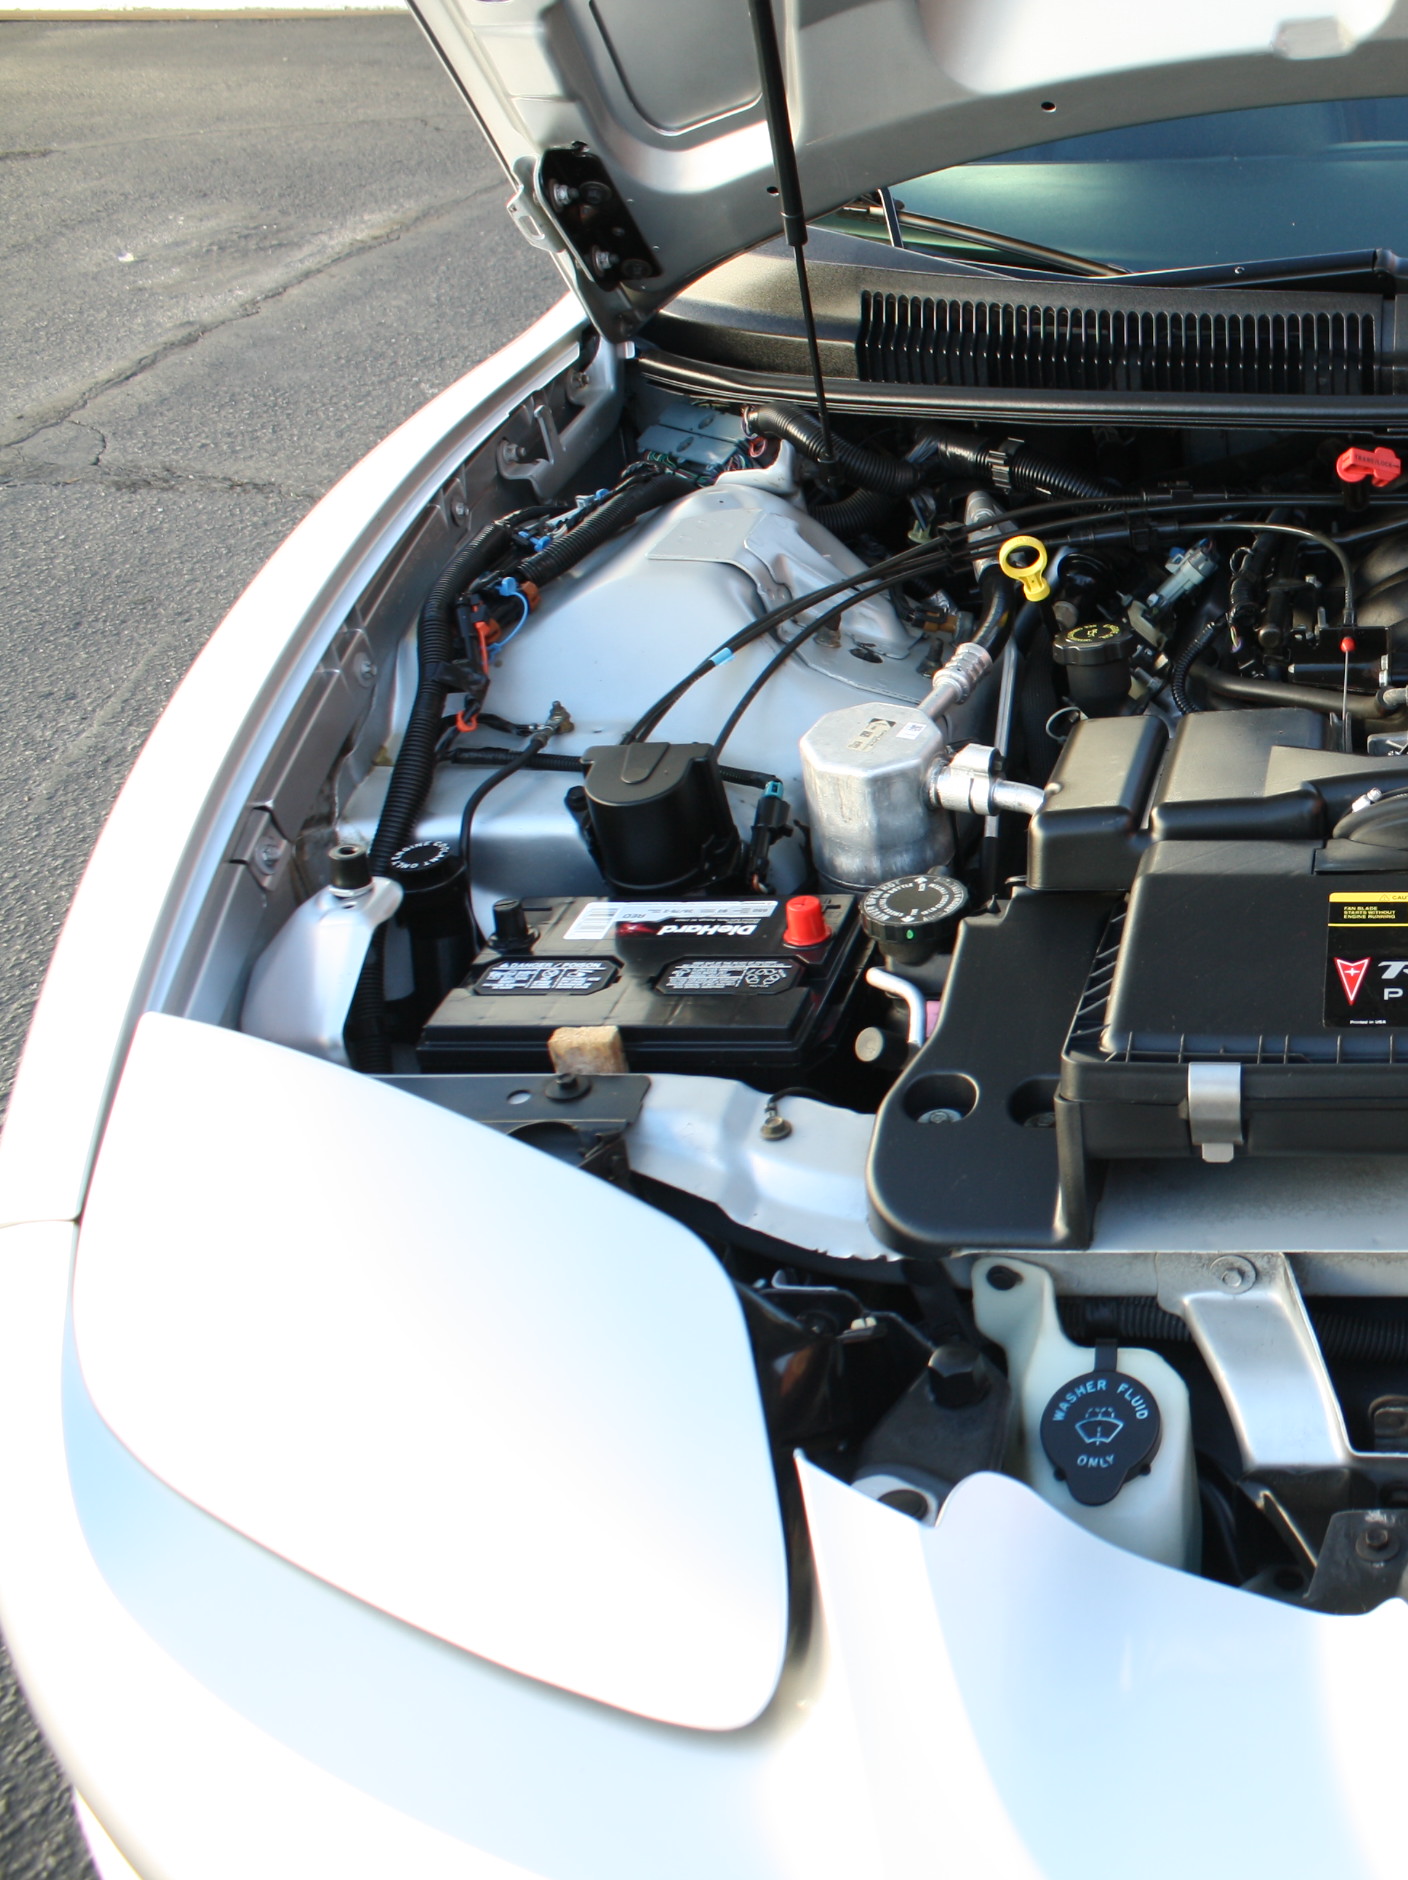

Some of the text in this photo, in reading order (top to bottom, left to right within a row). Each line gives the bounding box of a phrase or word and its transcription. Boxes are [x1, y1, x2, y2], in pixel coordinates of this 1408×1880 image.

[656, 924, 758, 936] DieHard
[1052, 1379, 1149, 1421] WASHER FLUID
[1076, 1454, 1115, 1469] ONLY
